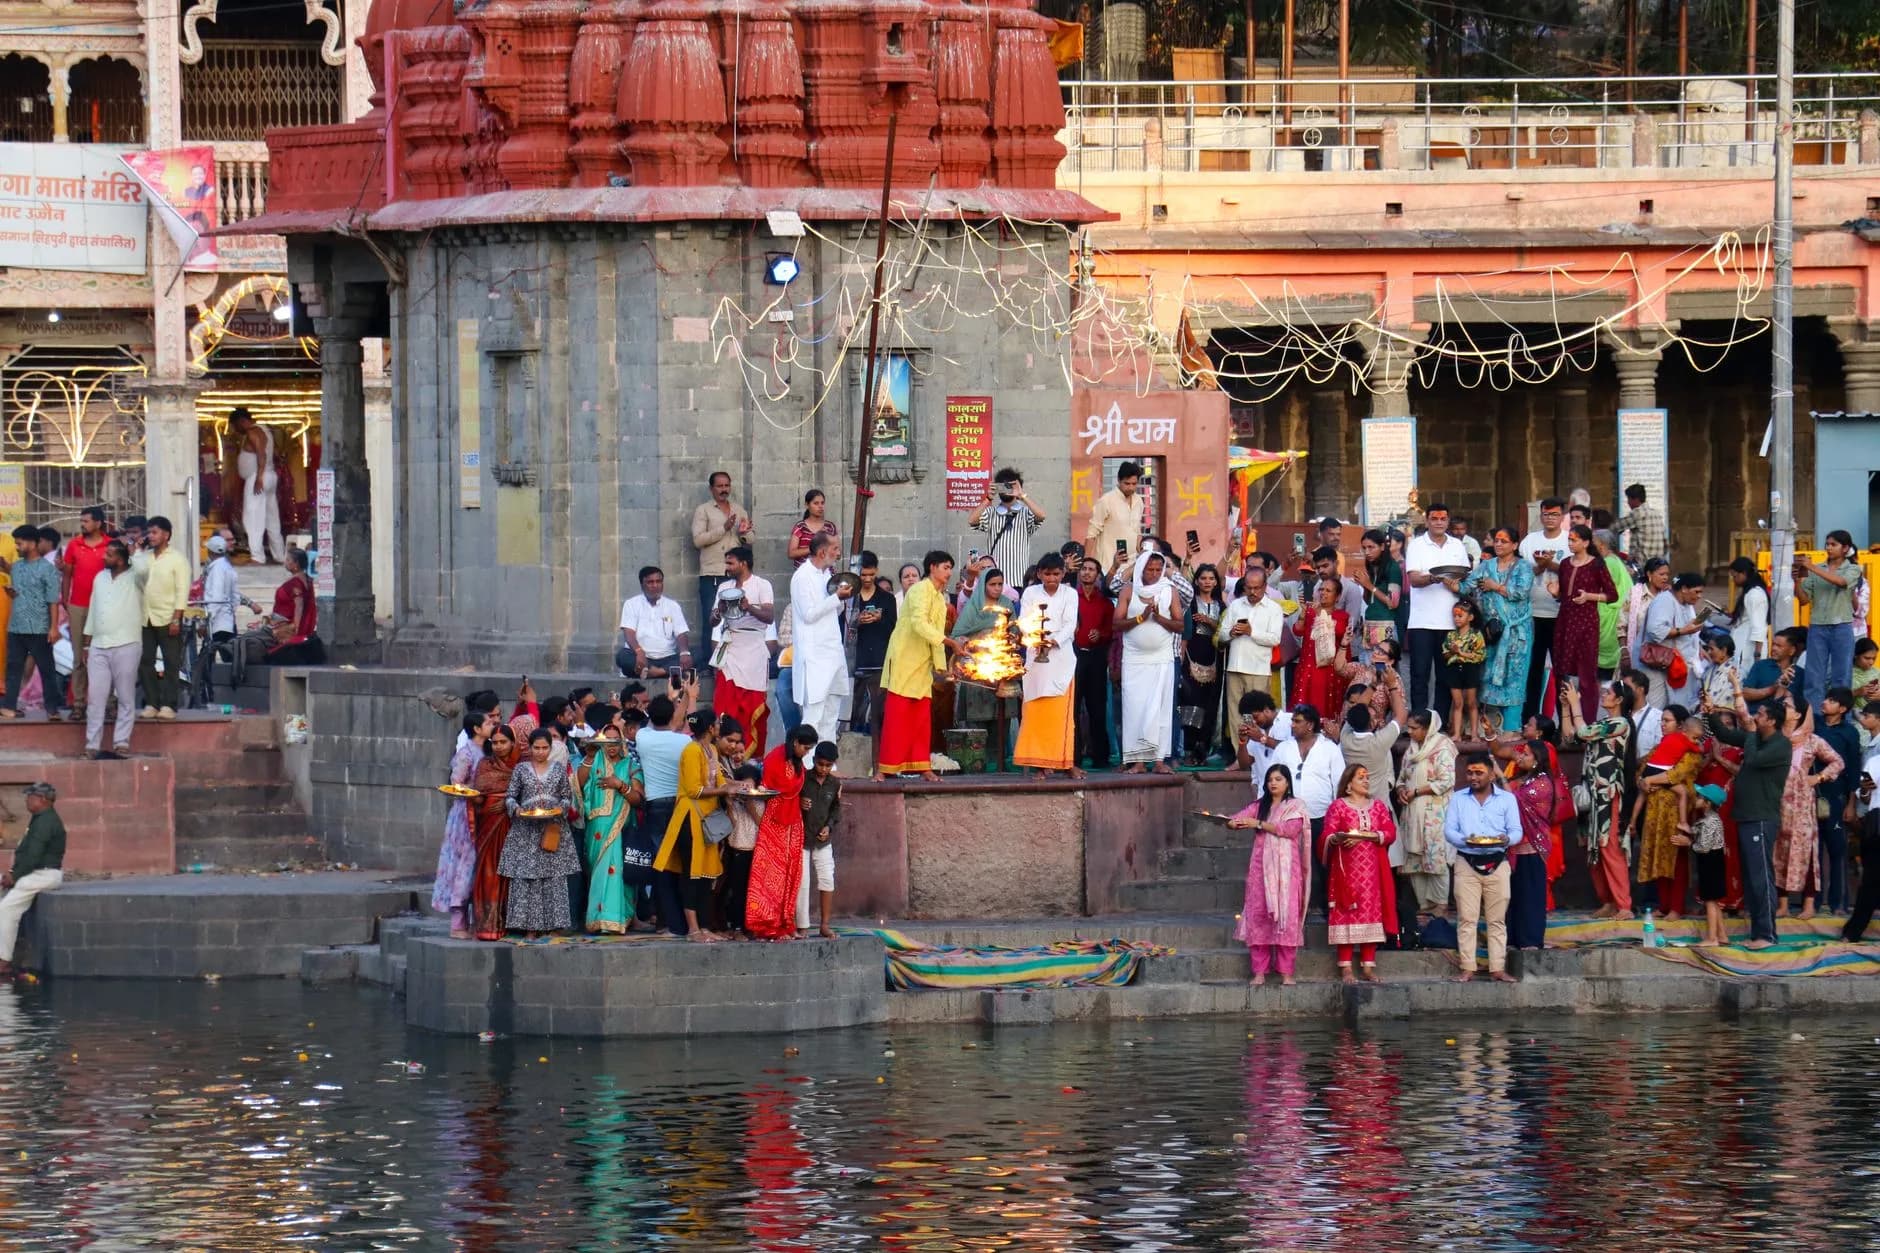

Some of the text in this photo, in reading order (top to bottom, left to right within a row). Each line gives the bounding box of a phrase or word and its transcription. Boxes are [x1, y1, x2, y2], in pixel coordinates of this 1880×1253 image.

[36, 176, 87, 200] माता
[91, 171, 143, 202] मंदिर
[25, 202, 66, 221] उज्जैन
[947, 402, 987, 413] कालसर्प
[954, 413, 979, 424] दोष
[950, 425, 984, 435] मंगल
[1078, 401, 1176, 455] श्री राम
[956, 434, 978, 445] दोष
[952, 446, 982, 460] पितृ
[952, 458, 982, 469] दोष
